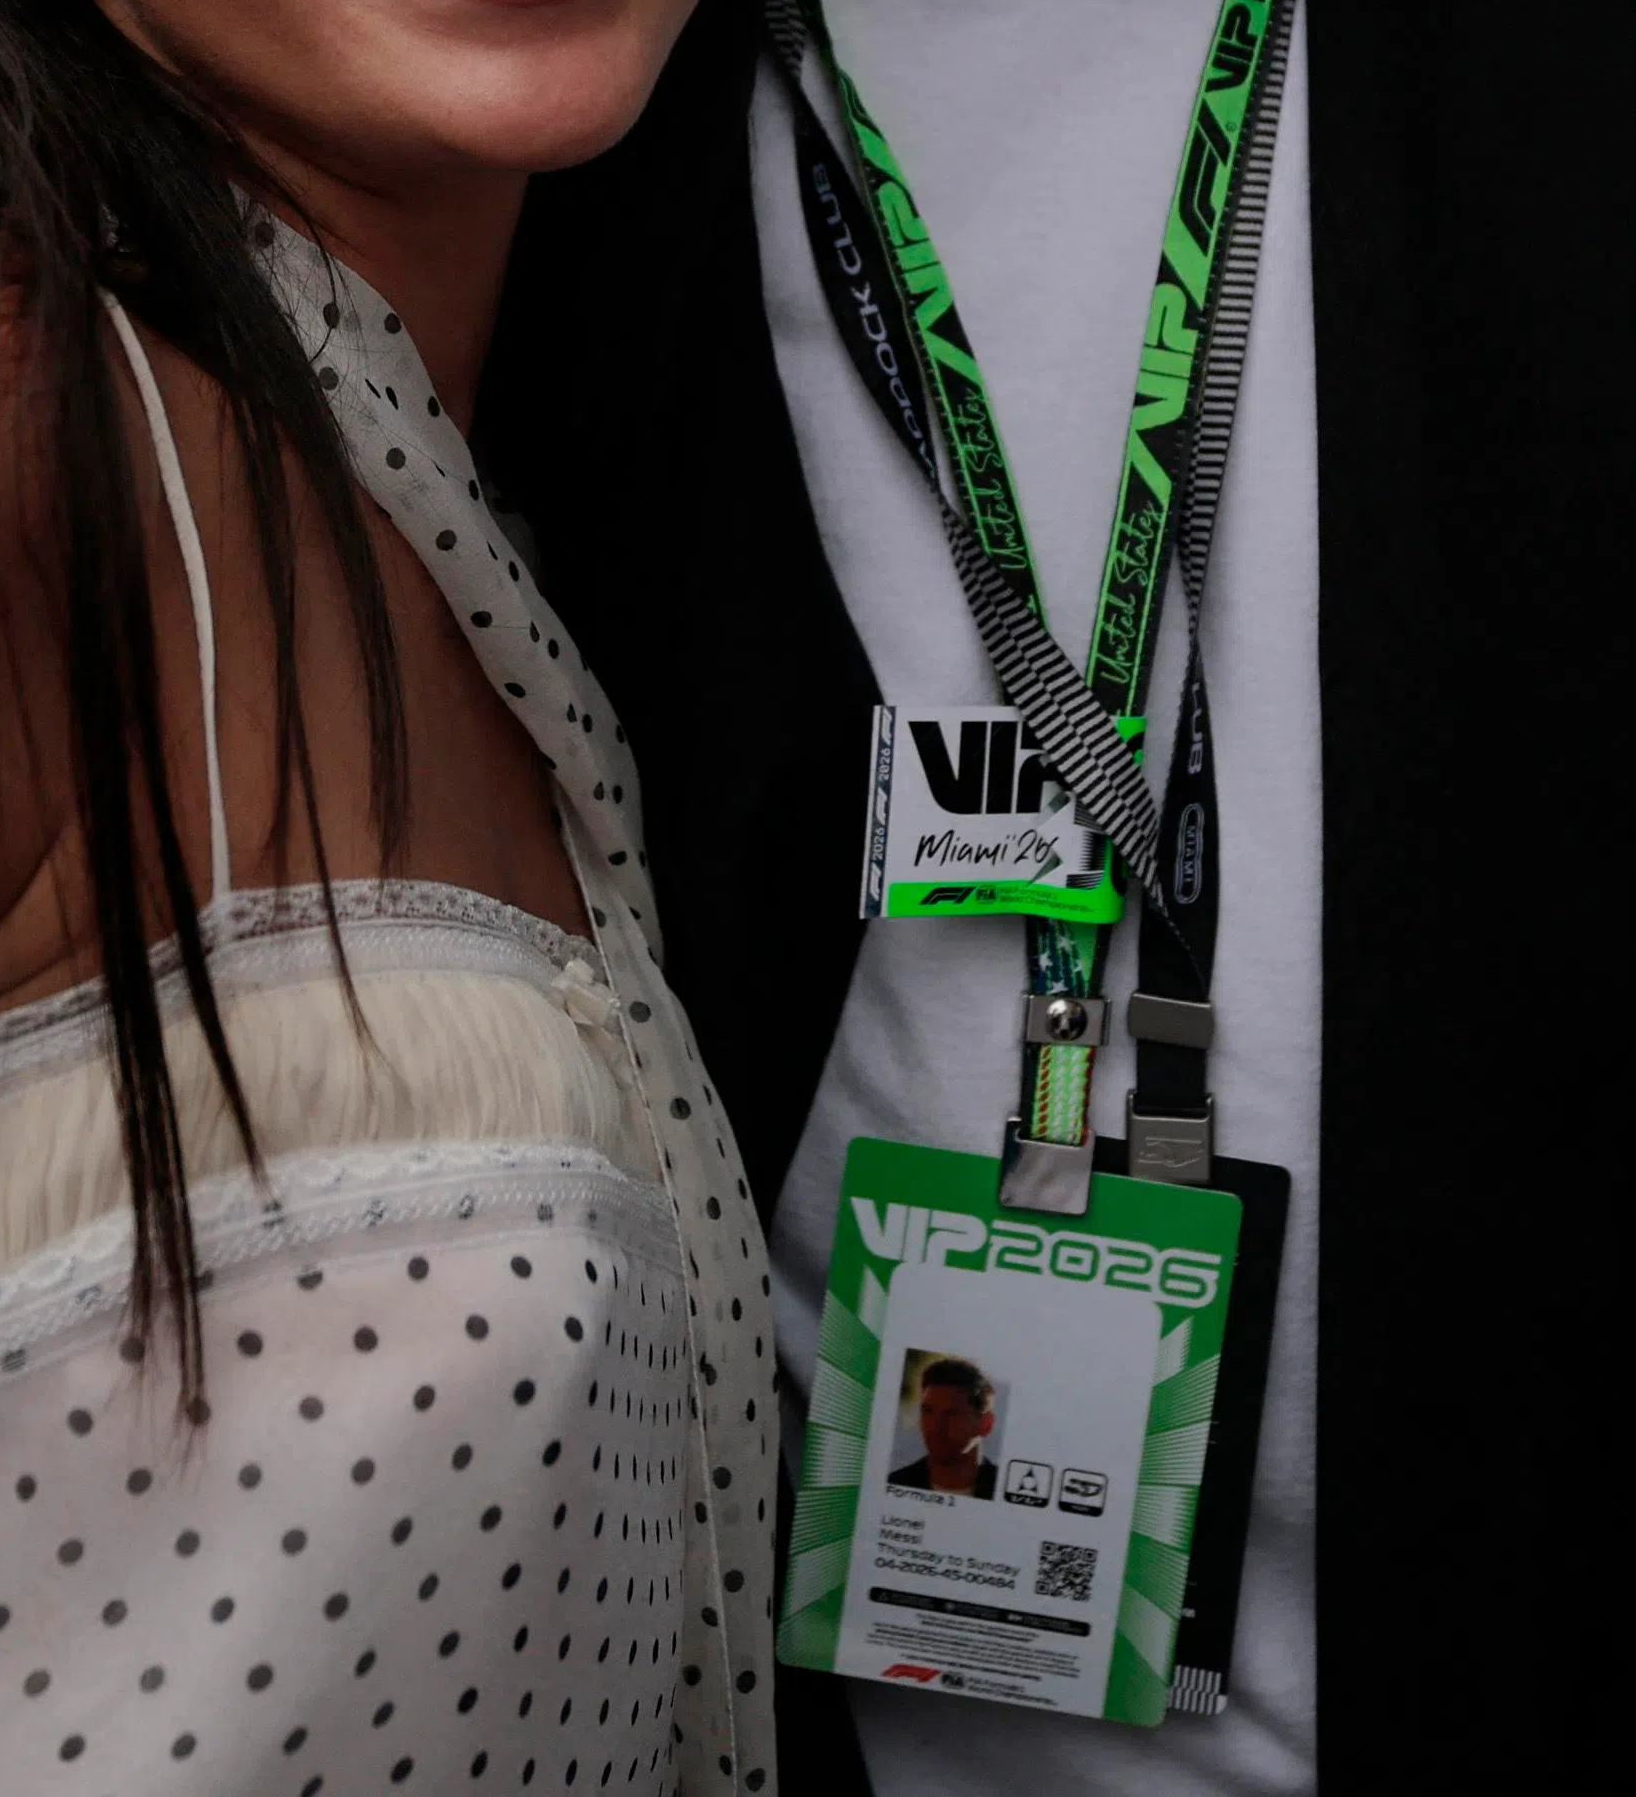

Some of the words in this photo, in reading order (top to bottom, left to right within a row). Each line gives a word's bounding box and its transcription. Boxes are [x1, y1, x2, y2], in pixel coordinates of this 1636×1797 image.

[1204, 4, 1258, 93] VIP
[811, 160, 863, 276] CLUB
[914, 829, 1010, 868] Miami
[880, 1530, 923, 1544] Messi
[882, 1515, 924, 1530] Lionel
[878, 1543, 944, 1563] Thursday
[948, 1554, 964, 1567] to
[967, 1558, 1020, 1577] Sunday
